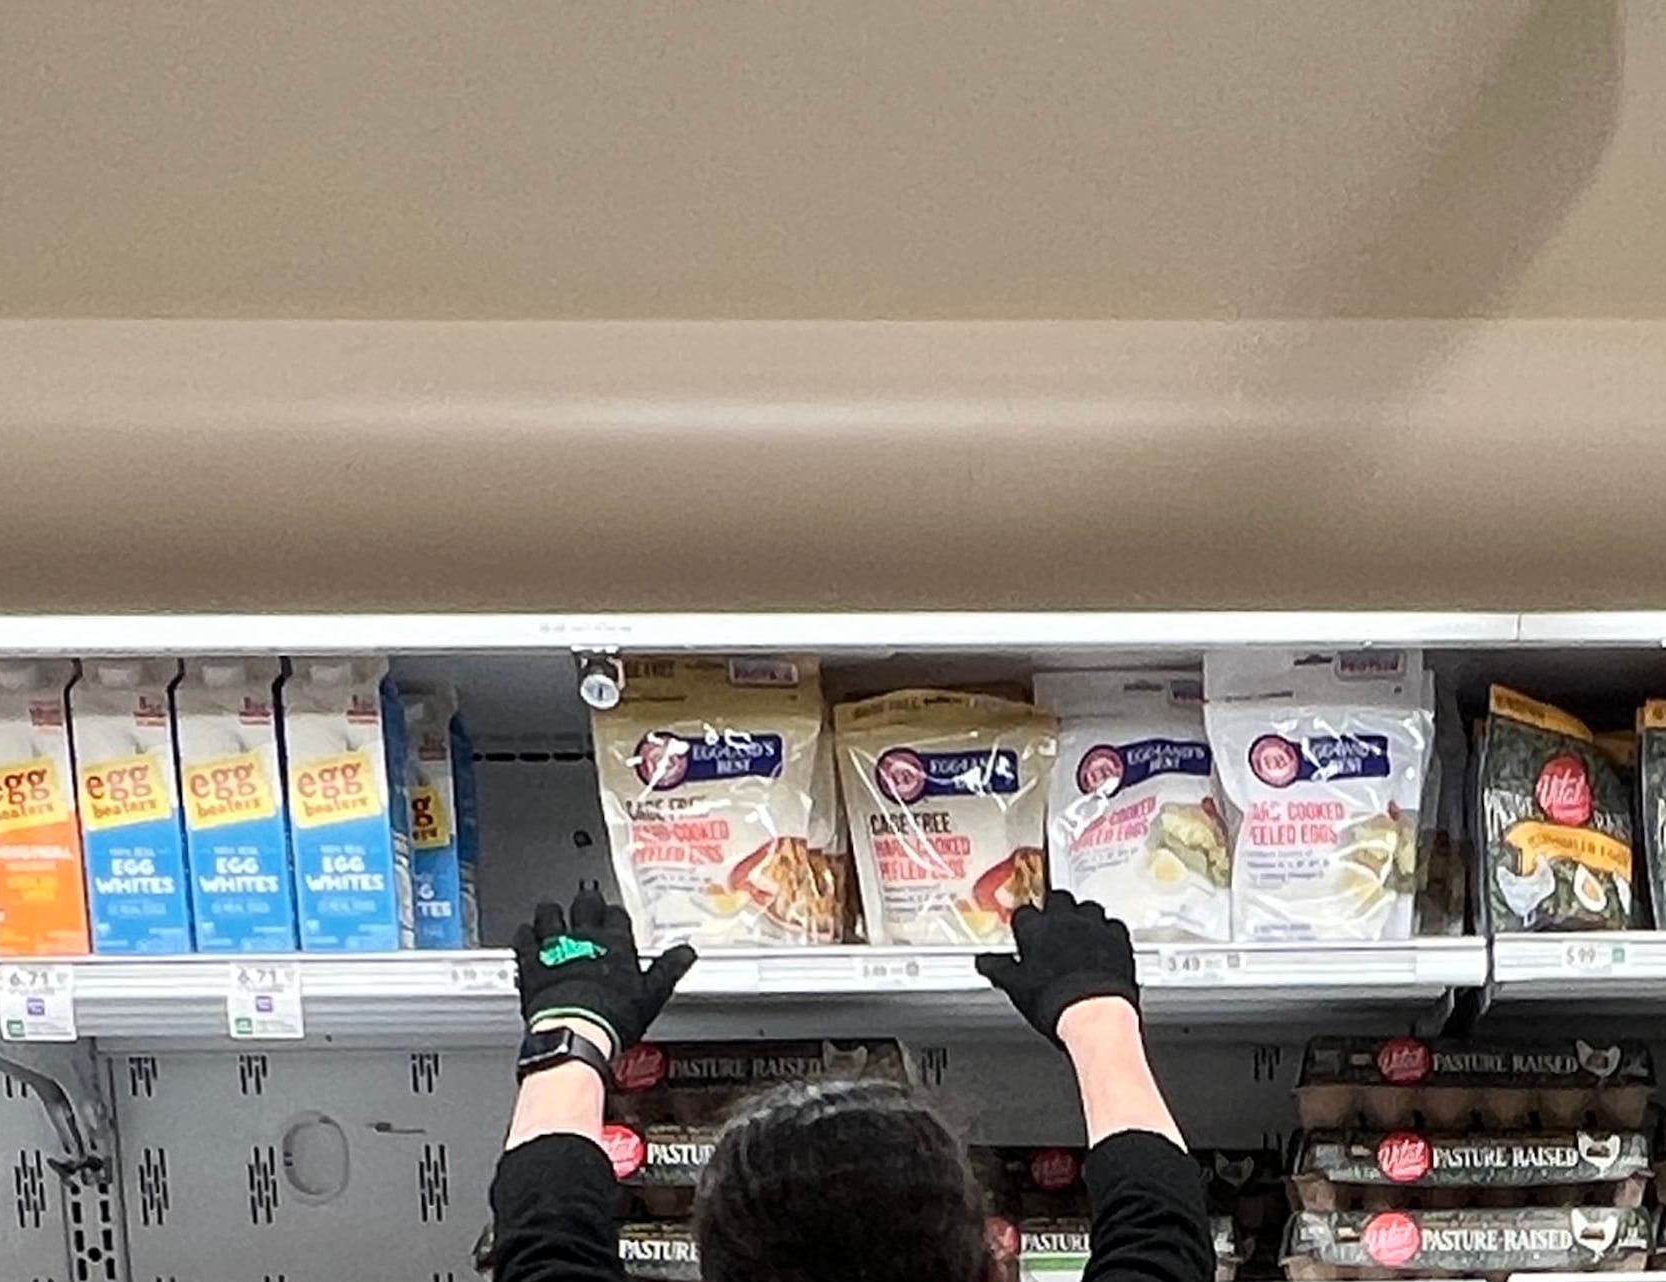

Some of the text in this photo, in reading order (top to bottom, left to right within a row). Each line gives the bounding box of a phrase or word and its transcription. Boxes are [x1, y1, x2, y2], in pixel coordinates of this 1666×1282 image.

[86, 765, 152, 801] egg
[190, 762, 256, 800] egg
[297, 762, 362, 799] egg
[111, 858, 155, 876] EGG
[216, 857, 259, 874] EGG
[322, 855, 365, 872] EGG
[95, 877, 175, 895] WHITES
[199, 875, 279, 893] WHITES
[305, 874, 383, 891] WHITES
[668, 1057, 746, 1079] PASTURE
[647, 1142, 717, 1166] PASTUR
